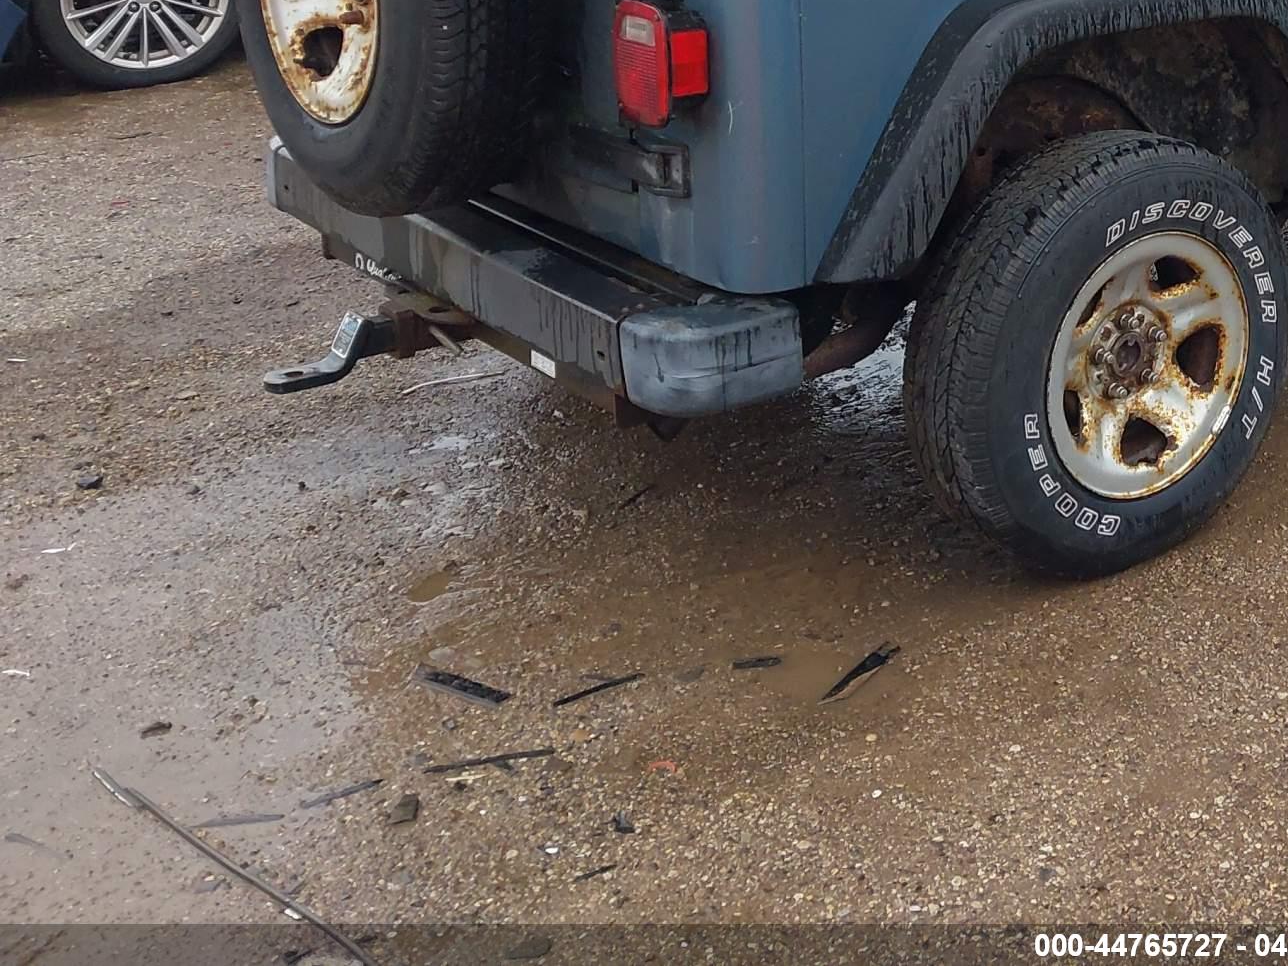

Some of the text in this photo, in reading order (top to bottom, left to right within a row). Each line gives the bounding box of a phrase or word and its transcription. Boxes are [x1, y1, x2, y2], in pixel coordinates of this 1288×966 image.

[1105, 200, 1277, 440] DISCOVERER H/T
[1024, 413, 1121, 536] COOPER
